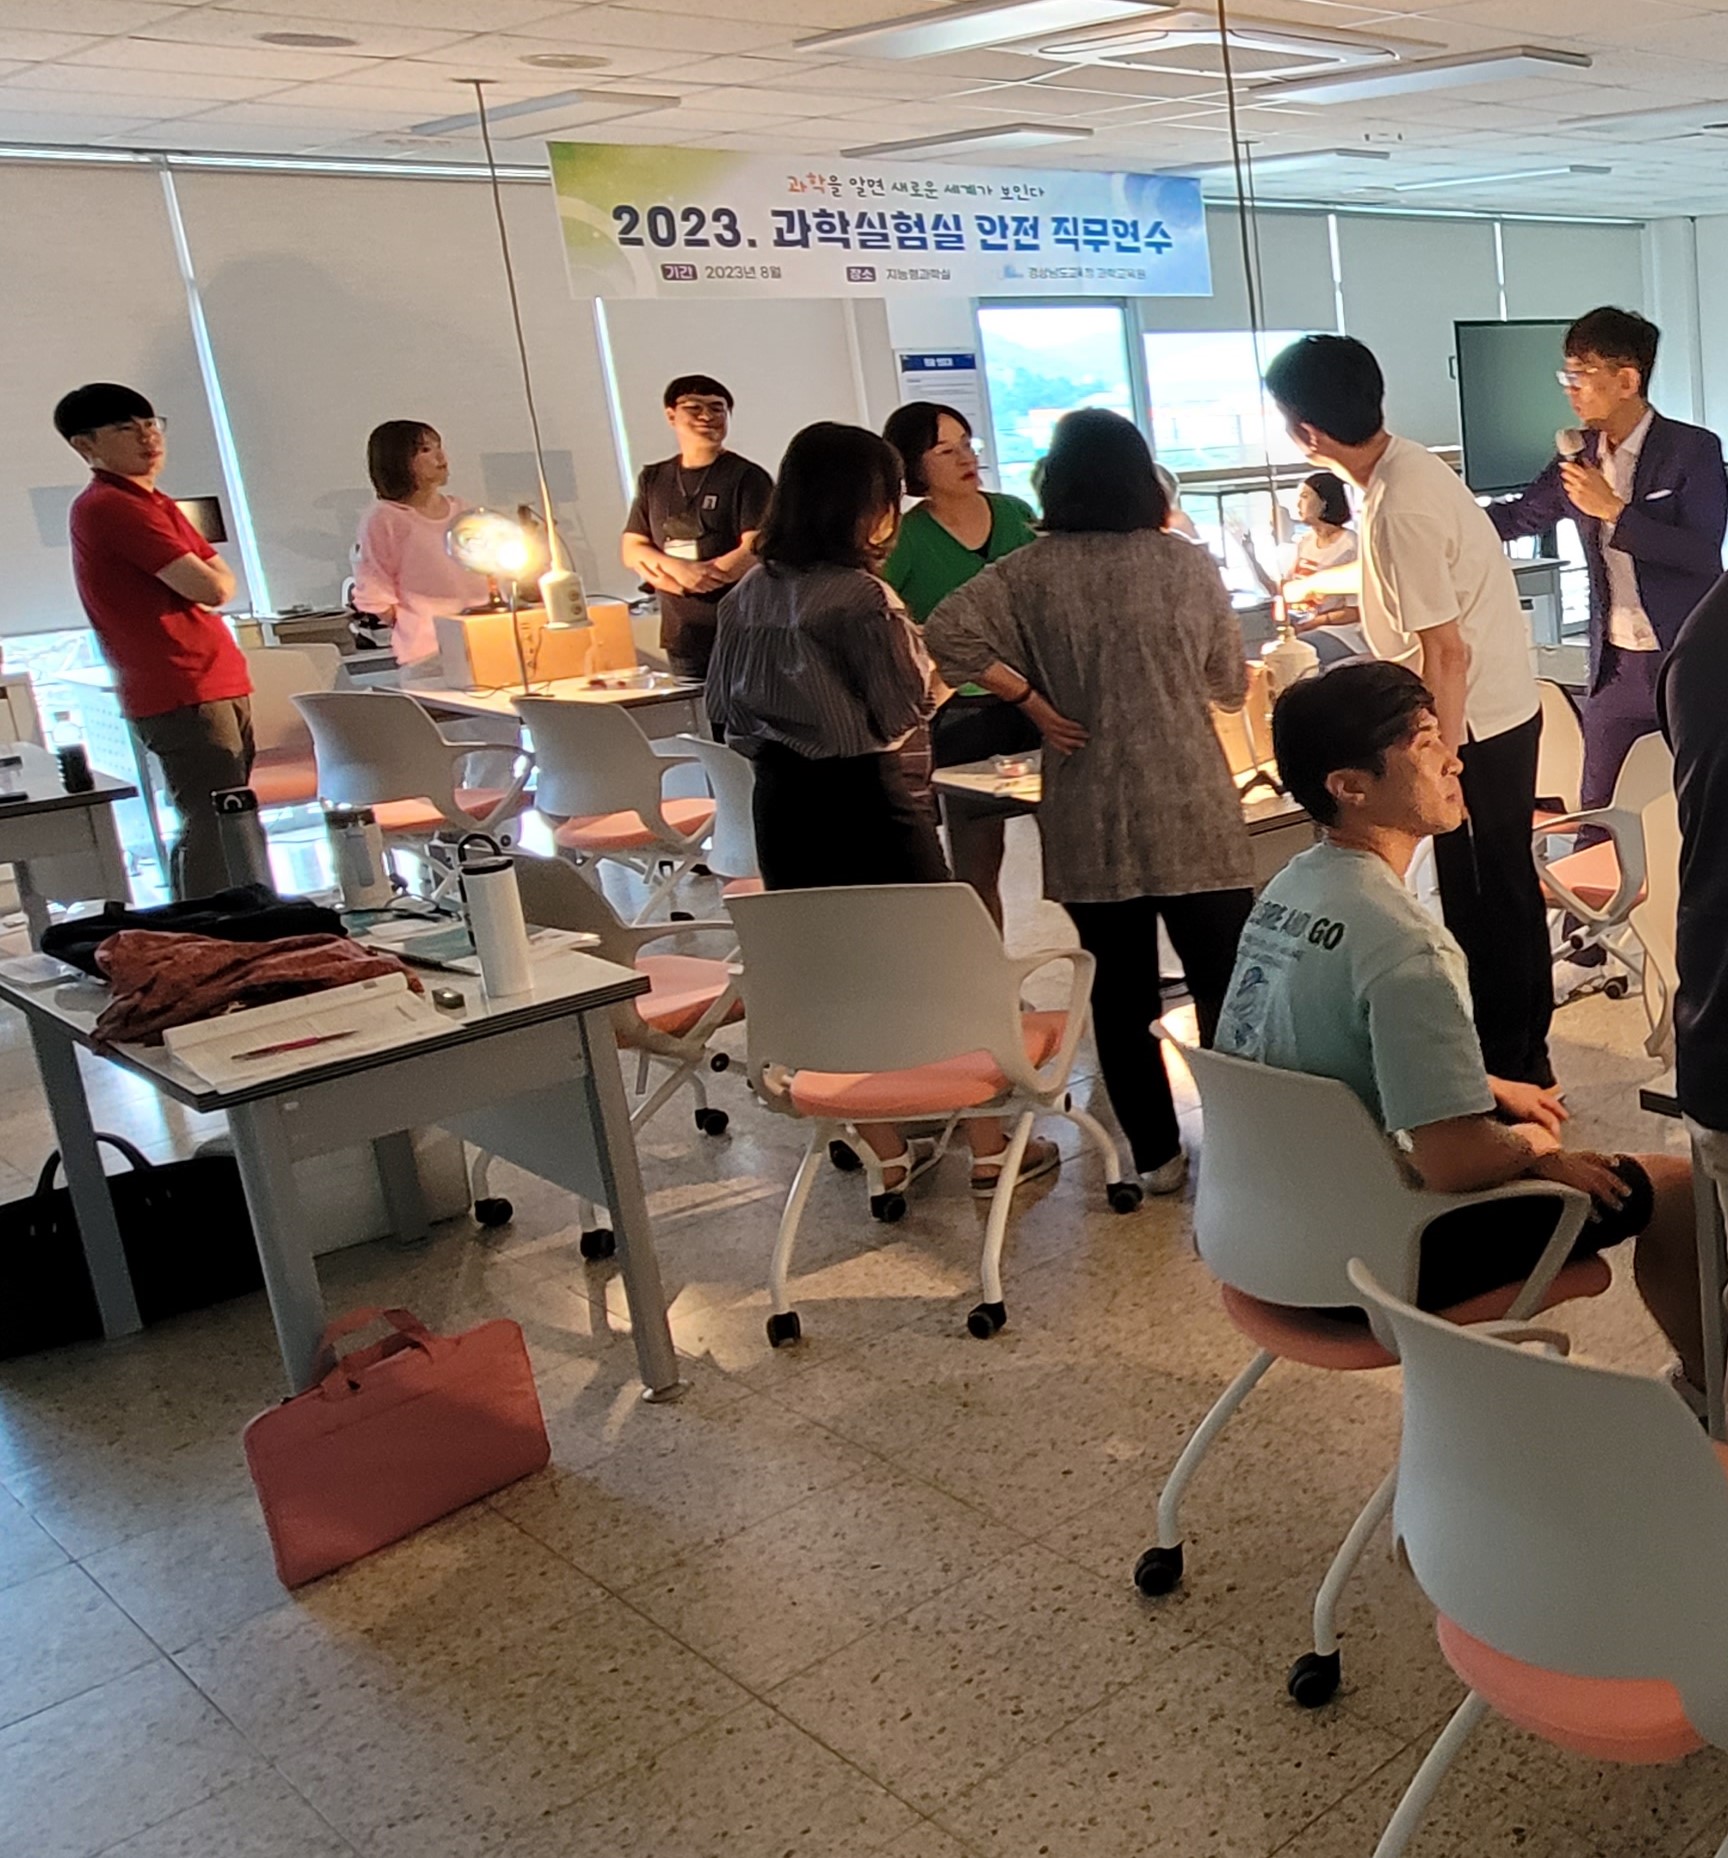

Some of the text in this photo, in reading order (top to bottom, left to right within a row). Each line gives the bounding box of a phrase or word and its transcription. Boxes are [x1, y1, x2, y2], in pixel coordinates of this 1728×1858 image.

[787, 172, 1045, 201] 과학을 알면 새로운 세계가 보인다
[612, 204, 1174, 254] 2023. 과학실험실 안전 직무연수
[665, 265, 782, 280] 기간 2023년 8월
[849, 267, 874, 281] 장소
[1307, 916, 1346, 951] GO
